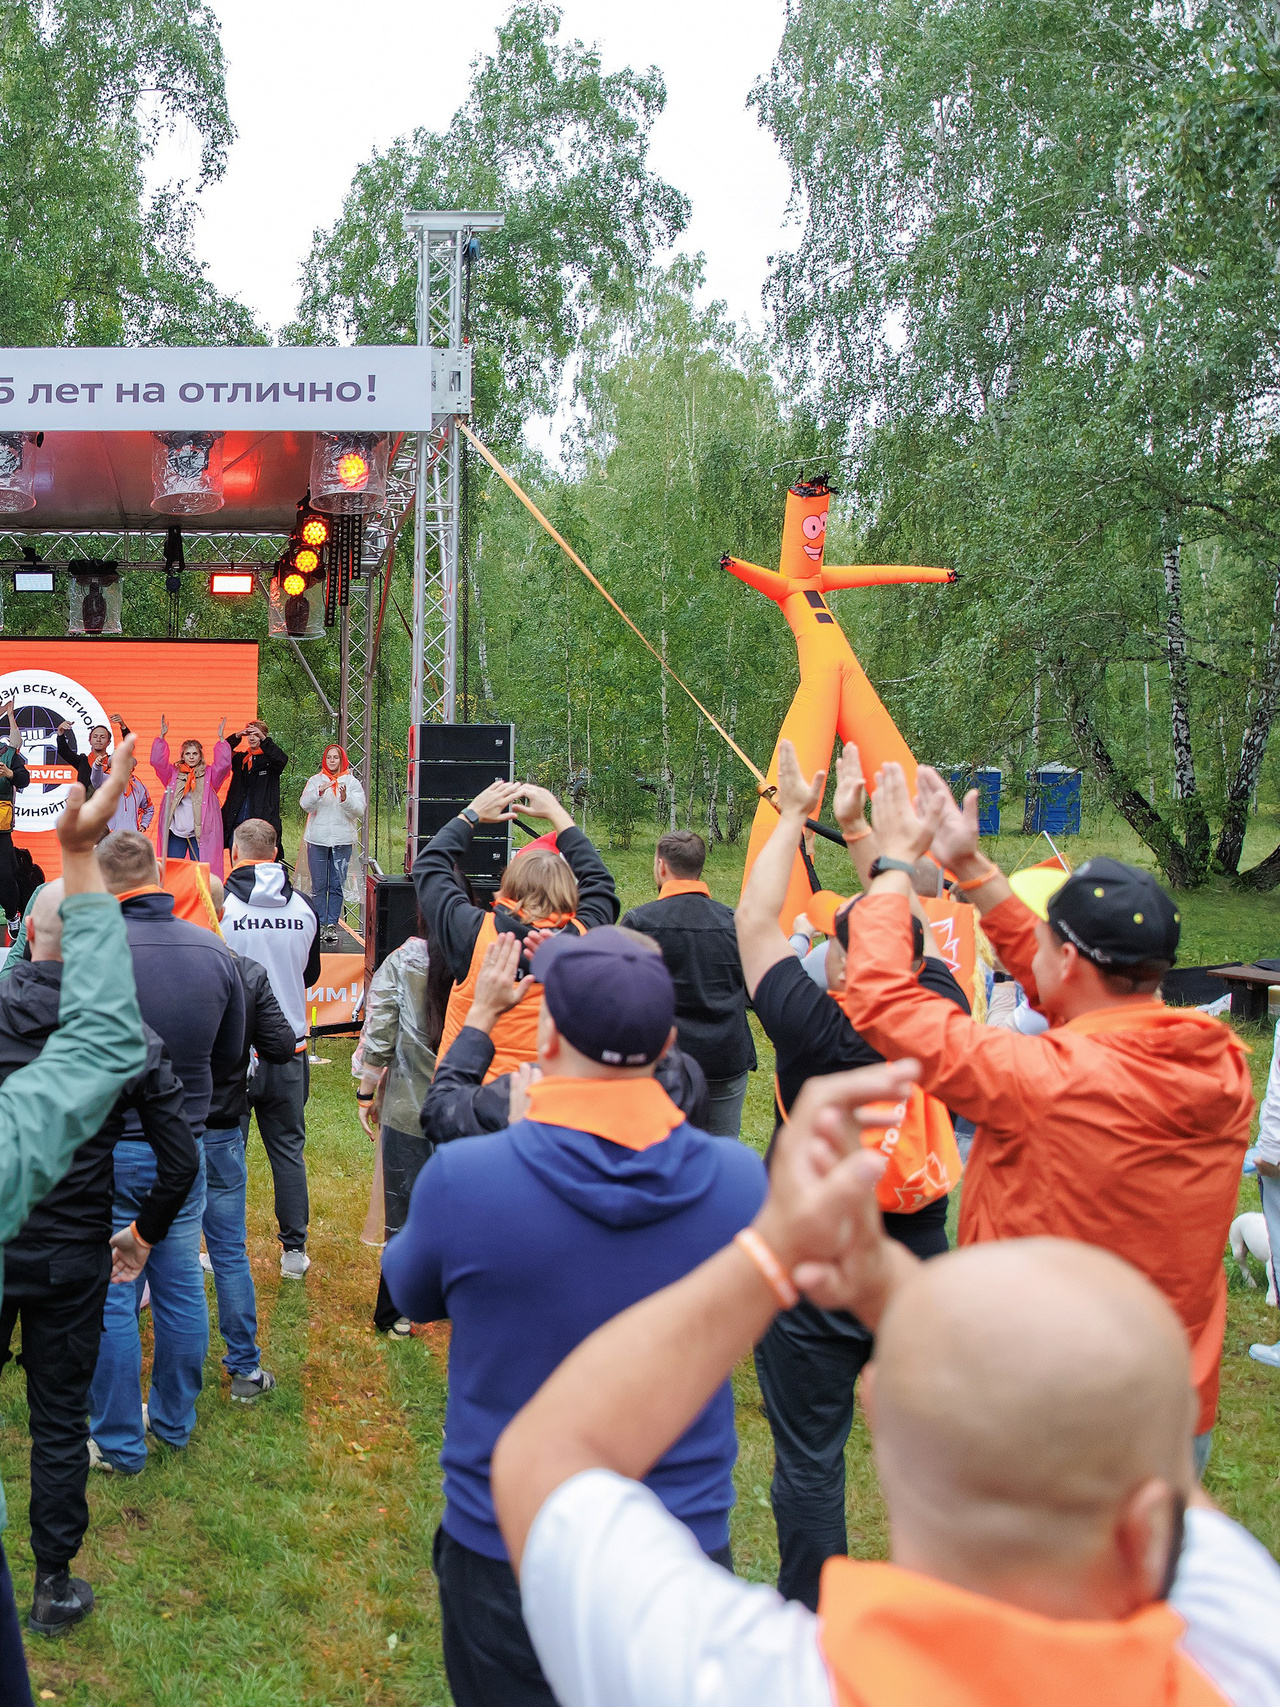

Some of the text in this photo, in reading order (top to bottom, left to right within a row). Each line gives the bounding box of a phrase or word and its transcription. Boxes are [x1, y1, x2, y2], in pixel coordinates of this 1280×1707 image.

[28, 383, 103, 404] лет
[115, 383, 166, 403] на
[178, 375, 377, 403] отлично!
[23, 684, 57, 696] ВСЕХ
[233, 914, 304, 931] KHABIB
